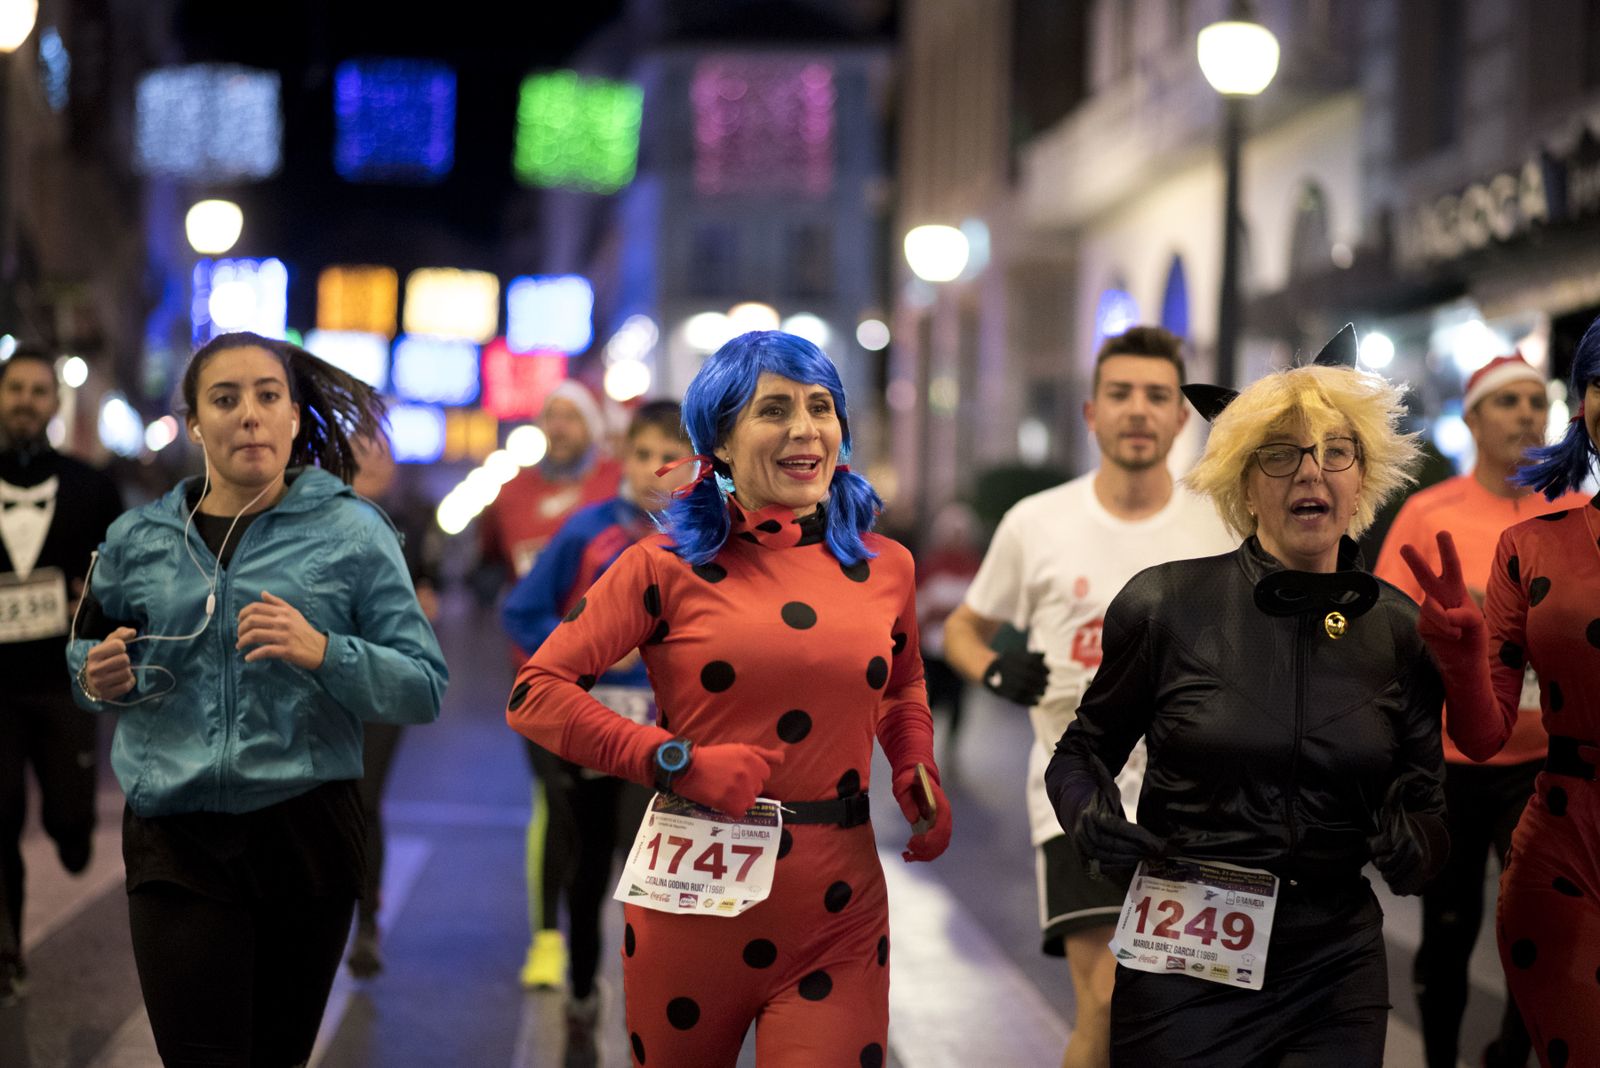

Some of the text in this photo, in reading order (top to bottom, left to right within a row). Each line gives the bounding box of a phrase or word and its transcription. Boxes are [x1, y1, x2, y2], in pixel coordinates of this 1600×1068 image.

[741, 829, 771, 838] GRANADA
[647, 832, 764, 882] 1747
[668, 879, 690, 891] GODINO
[690, 882, 705, 892] RUIZ
[1235, 896, 1264, 908] GRANADA
[1135, 896, 1255, 951] 1249
[1133, 938, 1155, 950] MARIOLA
[1173, 944, 1196, 957] GARCIA
